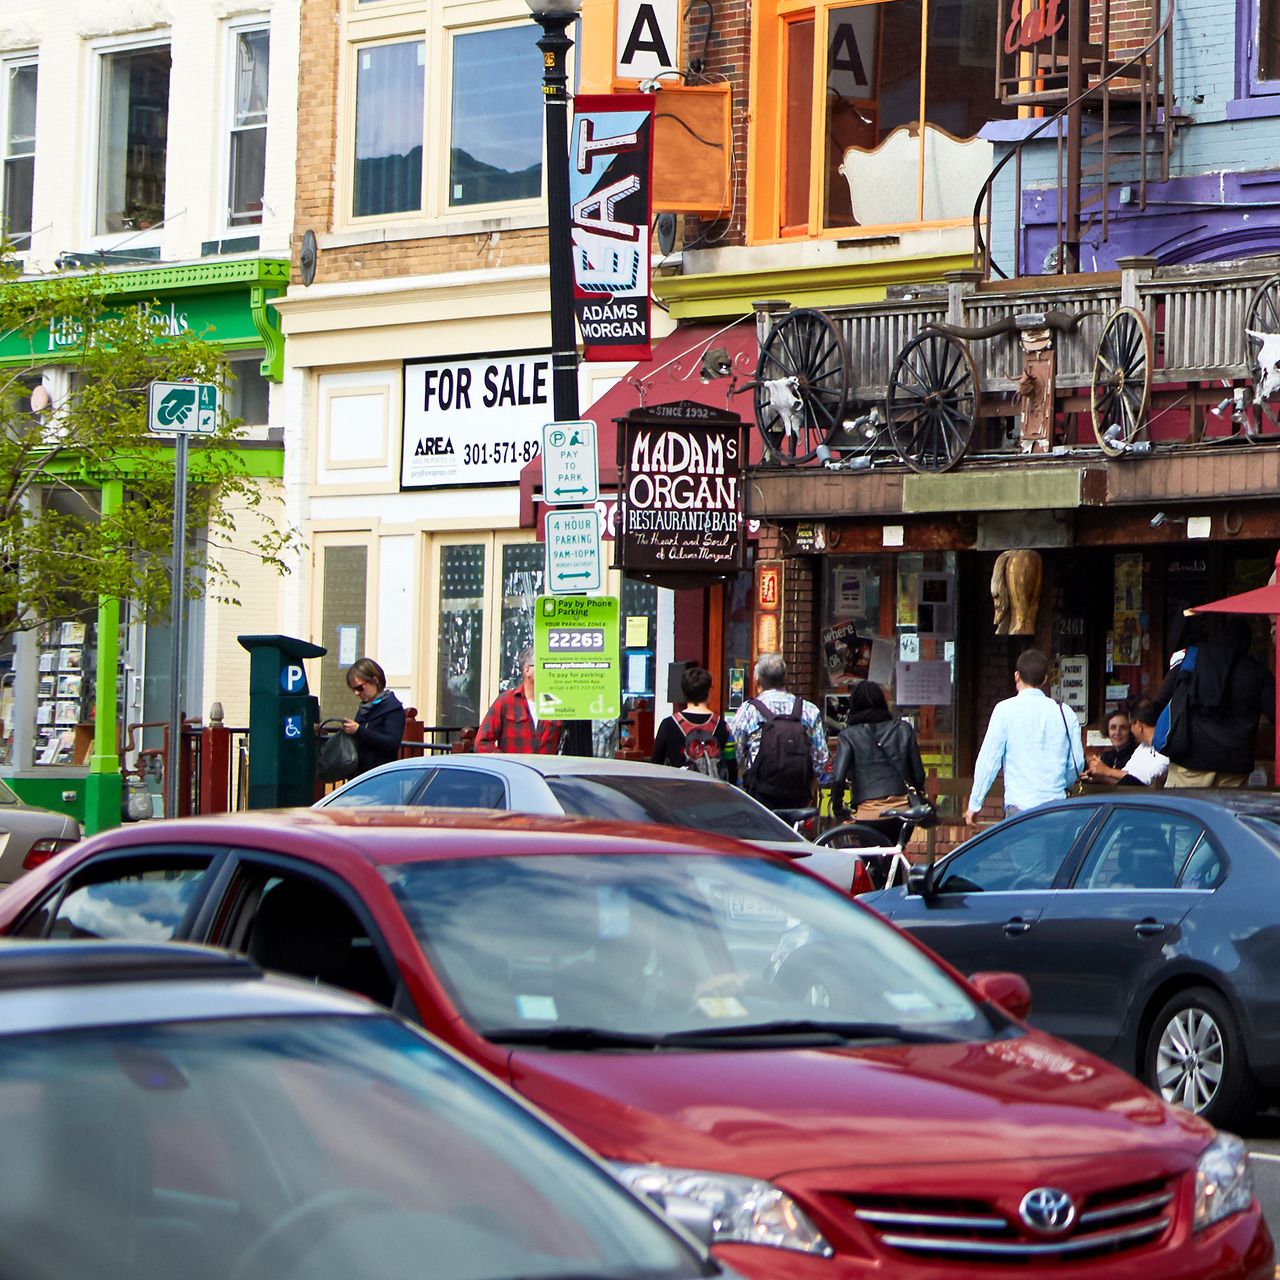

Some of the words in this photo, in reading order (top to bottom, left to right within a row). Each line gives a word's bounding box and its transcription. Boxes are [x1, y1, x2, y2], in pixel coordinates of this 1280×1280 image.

[583, 303, 638, 321] ADAMS
[581, 321, 646, 338] MORGAN
[424, 367, 472, 412] FOR
[483, 361, 549, 408] SALE
[202, 387, 209, 404] 4
[414, 436, 455, 456] AREA
[463, 440, 540, 466] 301-571-82
[561, 451, 578, 459] PAY
[631, 431, 737, 475] MADAM'S
[565, 462, 576, 470] TO
[629, 474, 736, 509] ORGAN
[554, 521, 559, 530] 4
[565, 520, 591, 530] HOUR
[629, 510, 704, 530] RESTAURANT
[712, 512, 737, 532] BAR
[556, 533, 592, 545] PARKING
[651, 533, 678, 546] Heart
[683, 535, 699, 546] and
[702, 532, 729, 547] Soul
[553, 549, 595, 559] 9AM-10PM
[559, 600, 572, 608] Pay
[575, 600, 584, 608] by
[558, 609, 589, 617] Parking
[549, 633, 603, 647] 22263
[288, 665, 302, 690] P
